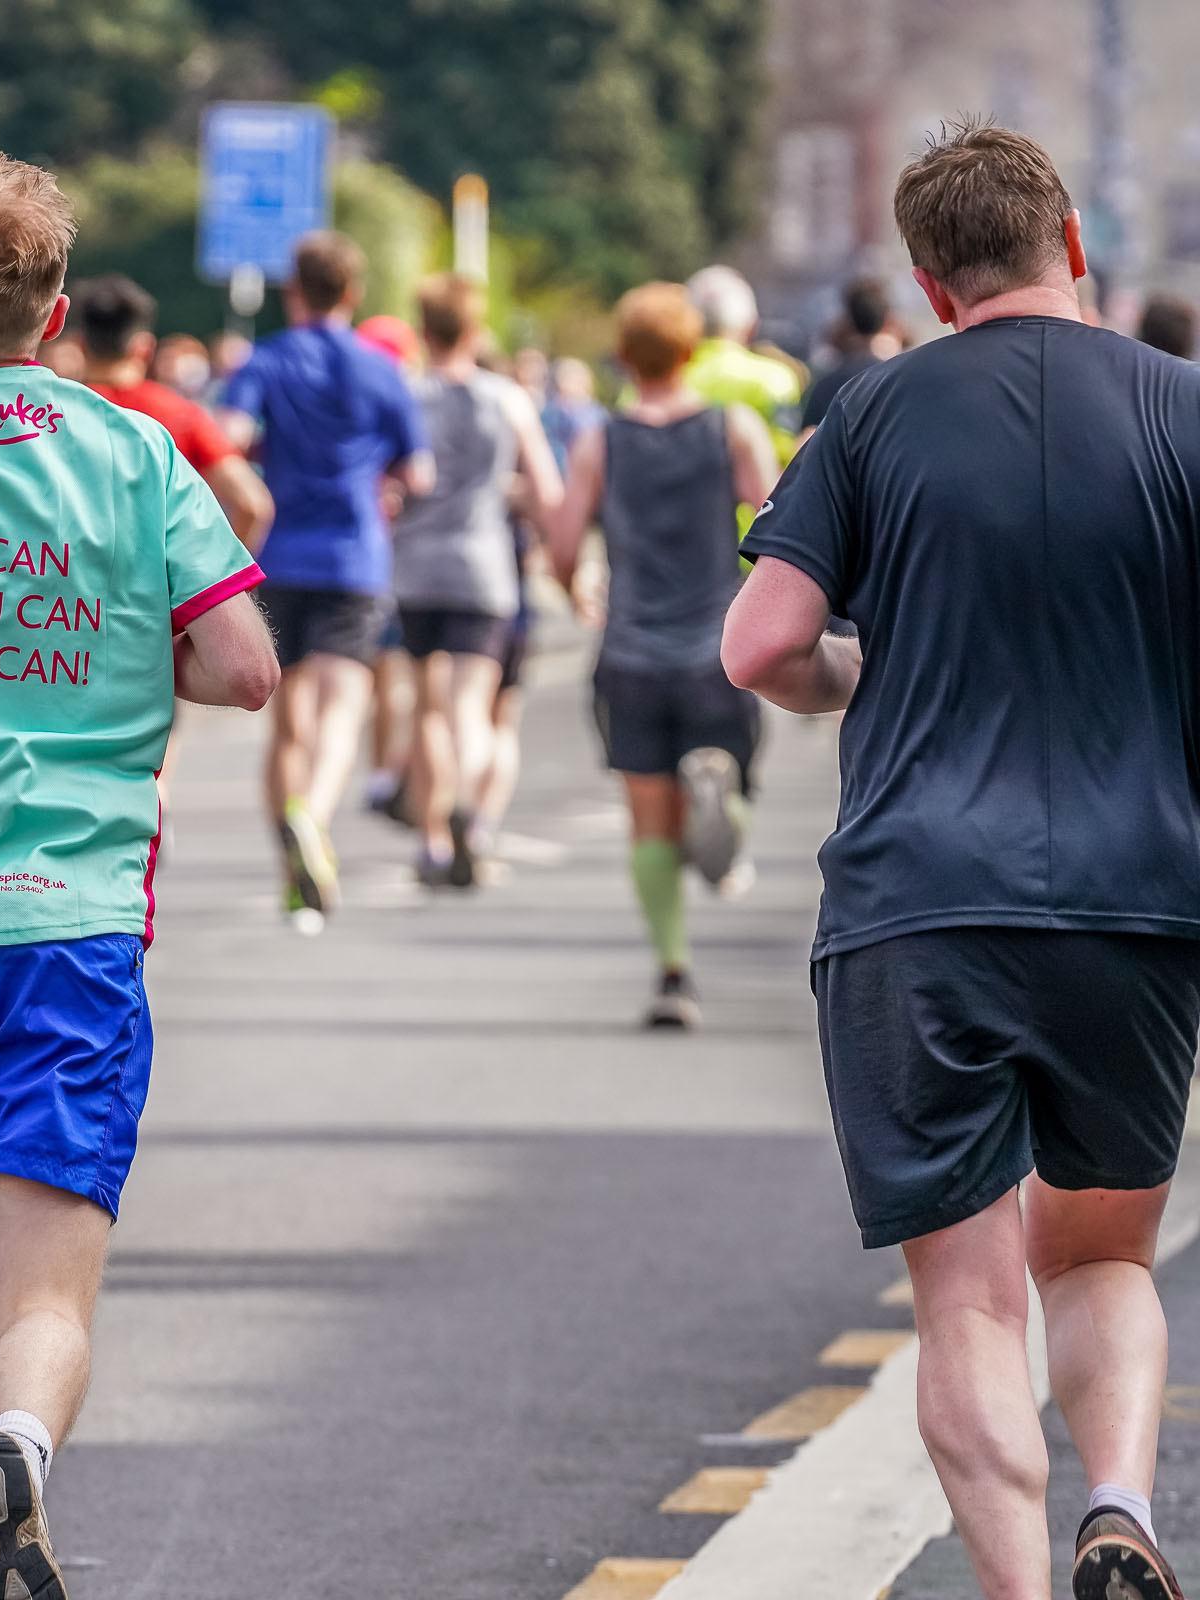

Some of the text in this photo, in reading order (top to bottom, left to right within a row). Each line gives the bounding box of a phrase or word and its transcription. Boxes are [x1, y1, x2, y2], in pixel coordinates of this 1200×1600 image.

[16, 594, 101, 633] CAN
[0, 885, 15, 893] No.
[16, 885, 44, 894] 254402
